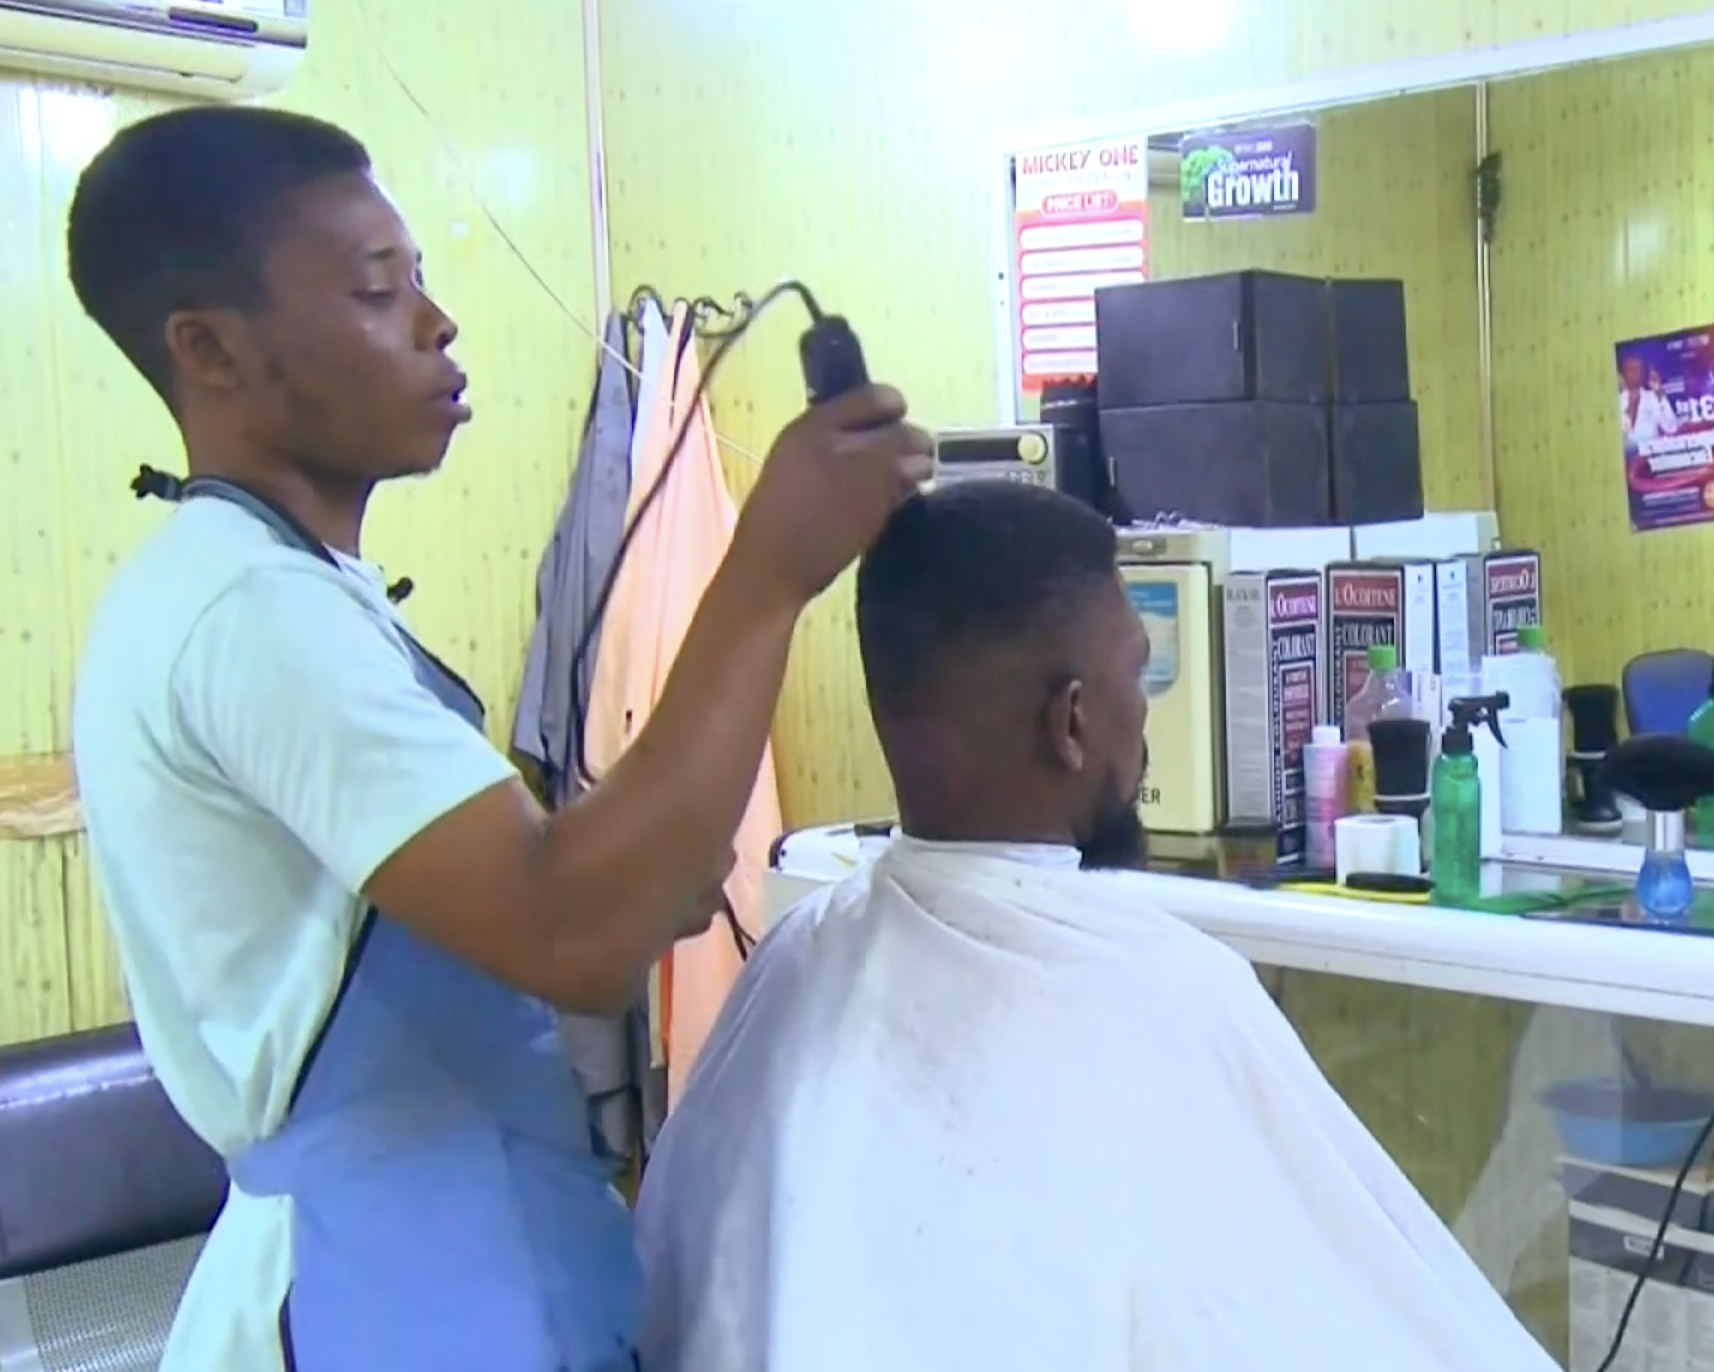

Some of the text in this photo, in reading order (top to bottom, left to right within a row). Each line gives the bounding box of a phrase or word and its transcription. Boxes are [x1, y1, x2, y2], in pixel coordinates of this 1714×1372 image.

[1022, 144, 1139, 175] MICKEY ONE
[1207, 169, 1299, 208] Growth
[1140, 786, 1161, 806] ER
